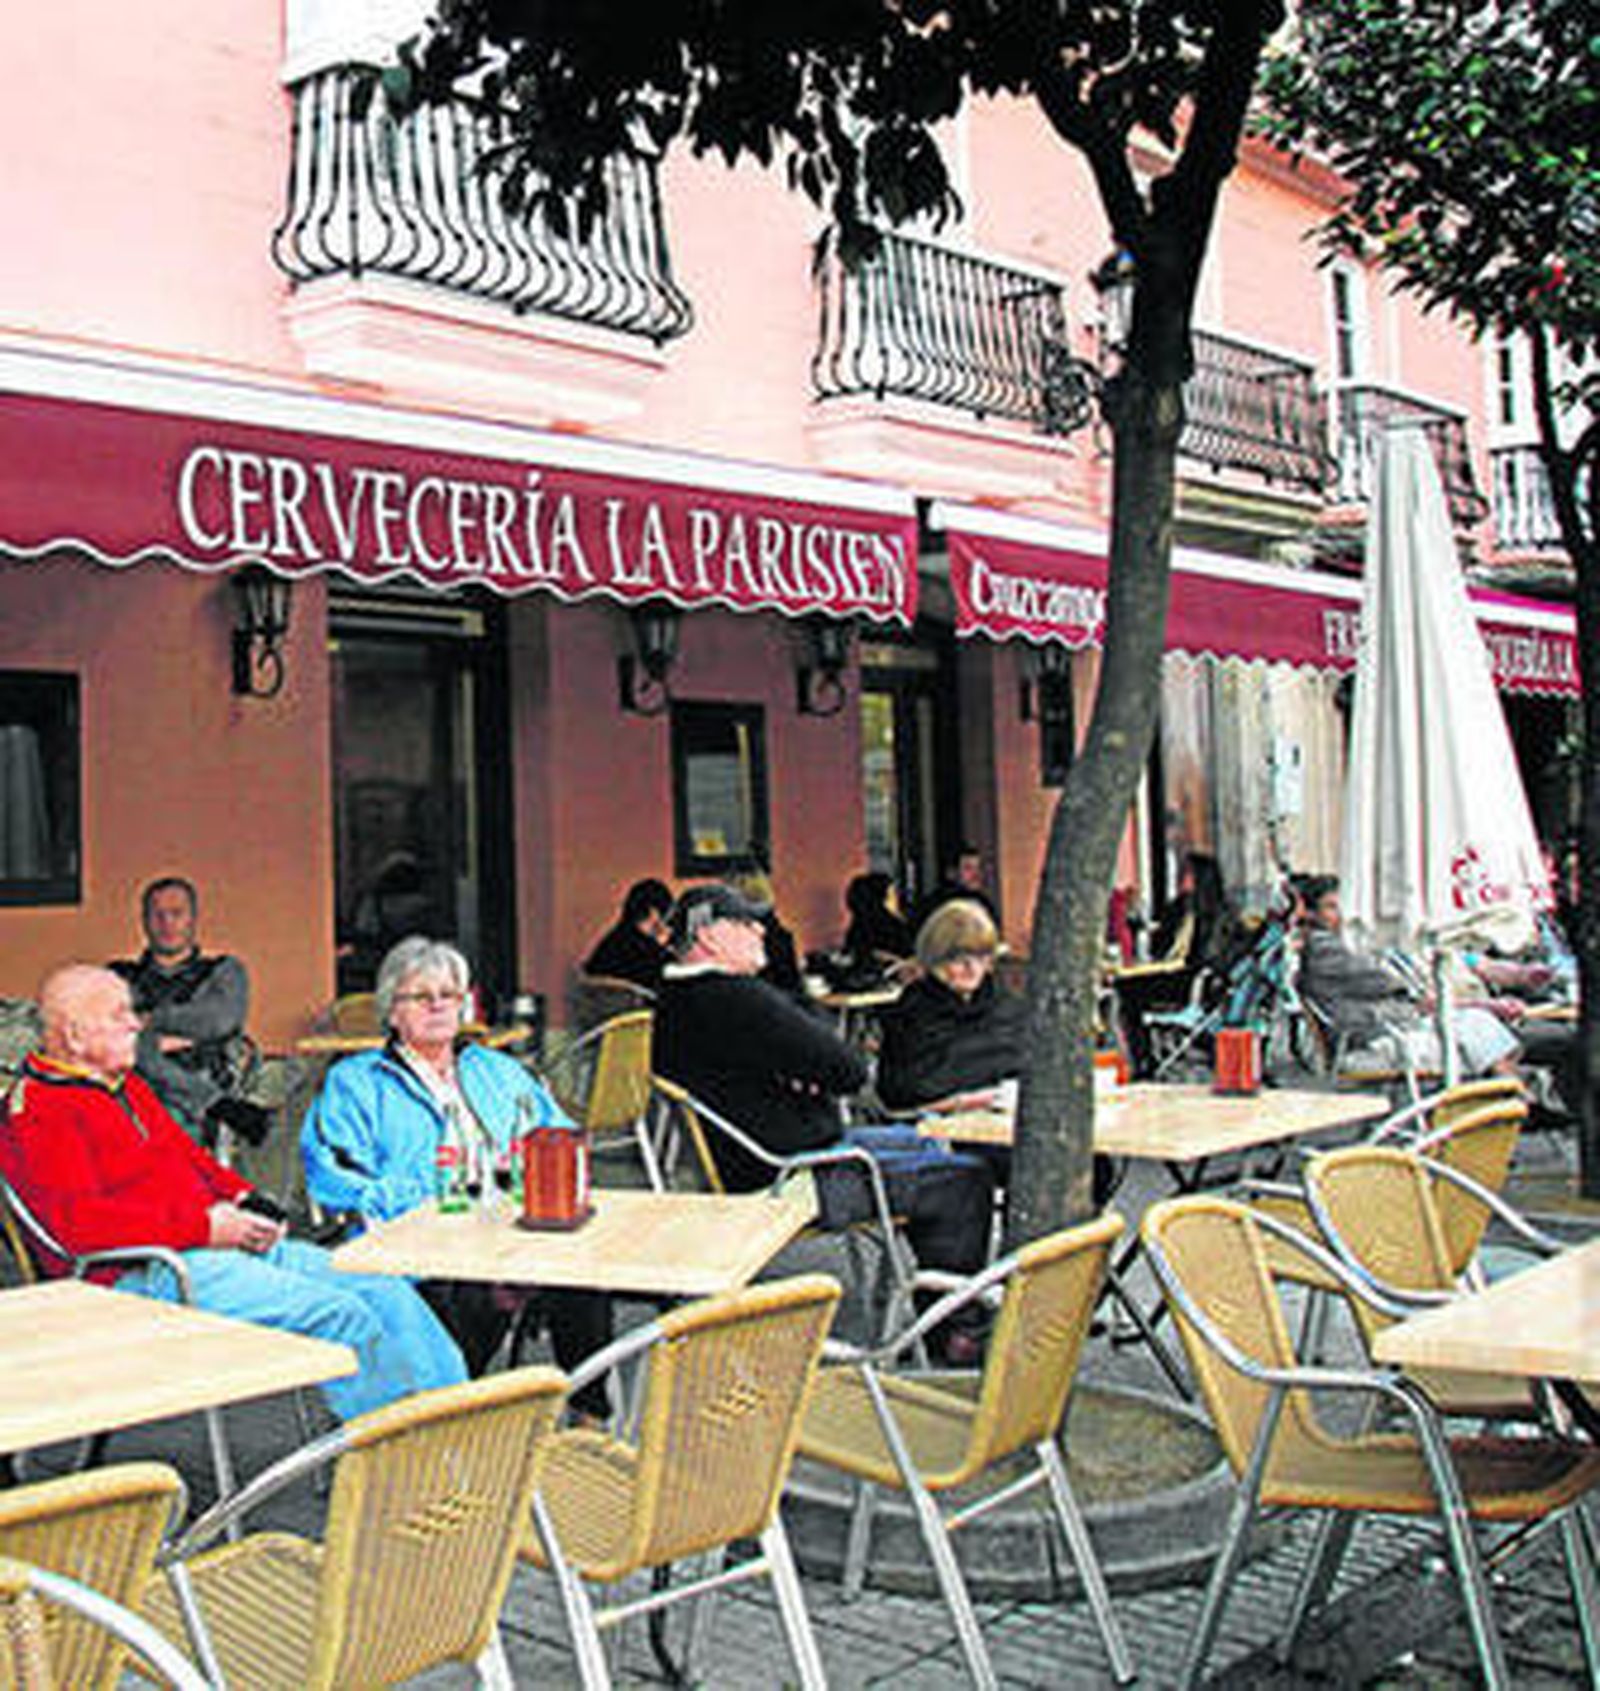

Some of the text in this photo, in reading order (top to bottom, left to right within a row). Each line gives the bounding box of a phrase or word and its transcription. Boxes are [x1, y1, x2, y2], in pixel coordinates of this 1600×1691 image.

[178, 447, 905, 605] CERVECERÍA LA PARISIEN
